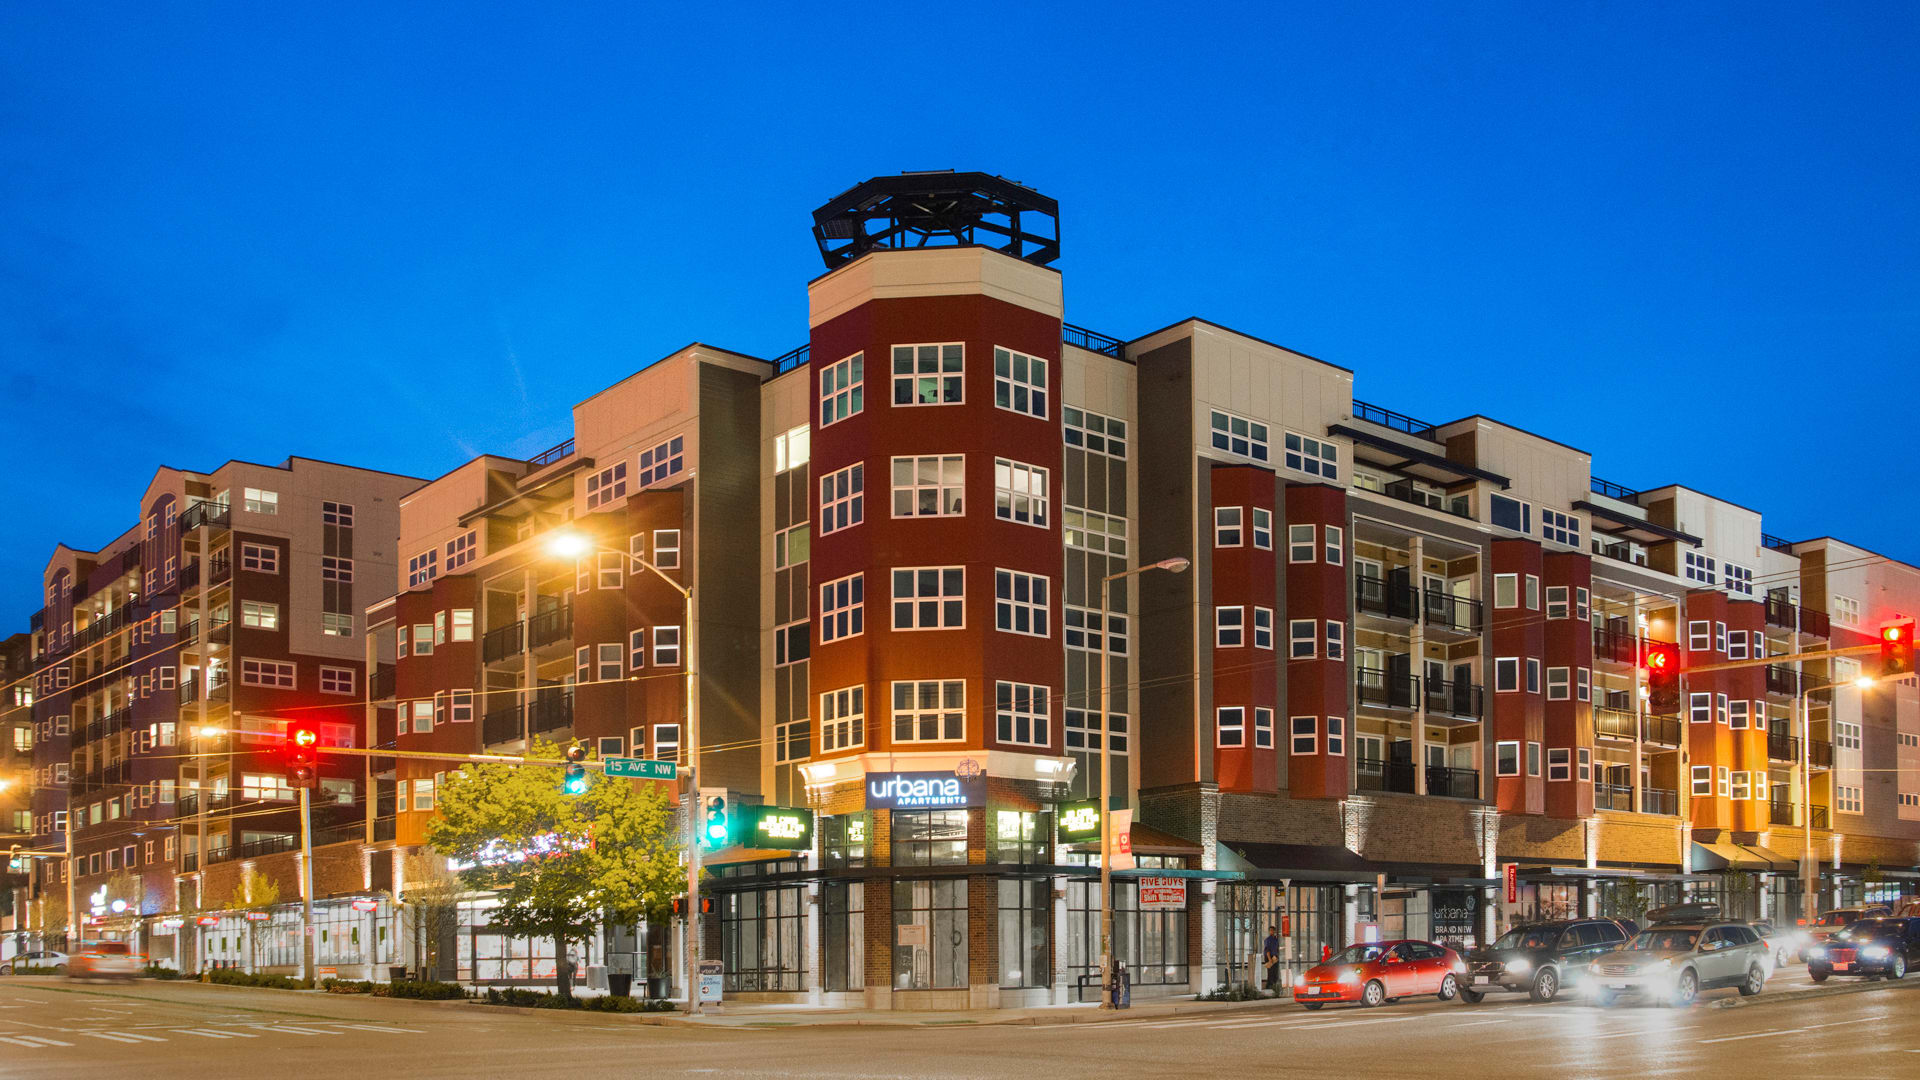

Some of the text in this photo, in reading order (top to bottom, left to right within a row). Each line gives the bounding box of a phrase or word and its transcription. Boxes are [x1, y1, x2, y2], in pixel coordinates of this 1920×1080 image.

[611, 761, 671, 775] 15 AVE NW
[871, 775, 960, 798] urbana
[897, 796, 967, 805] APARTMENTS
[1141, 877, 1184, 886] FIVE GUYS
[1434, 904, 1469, 919] urbana
[1435, 925, 1472, 934] BRAND NEW
